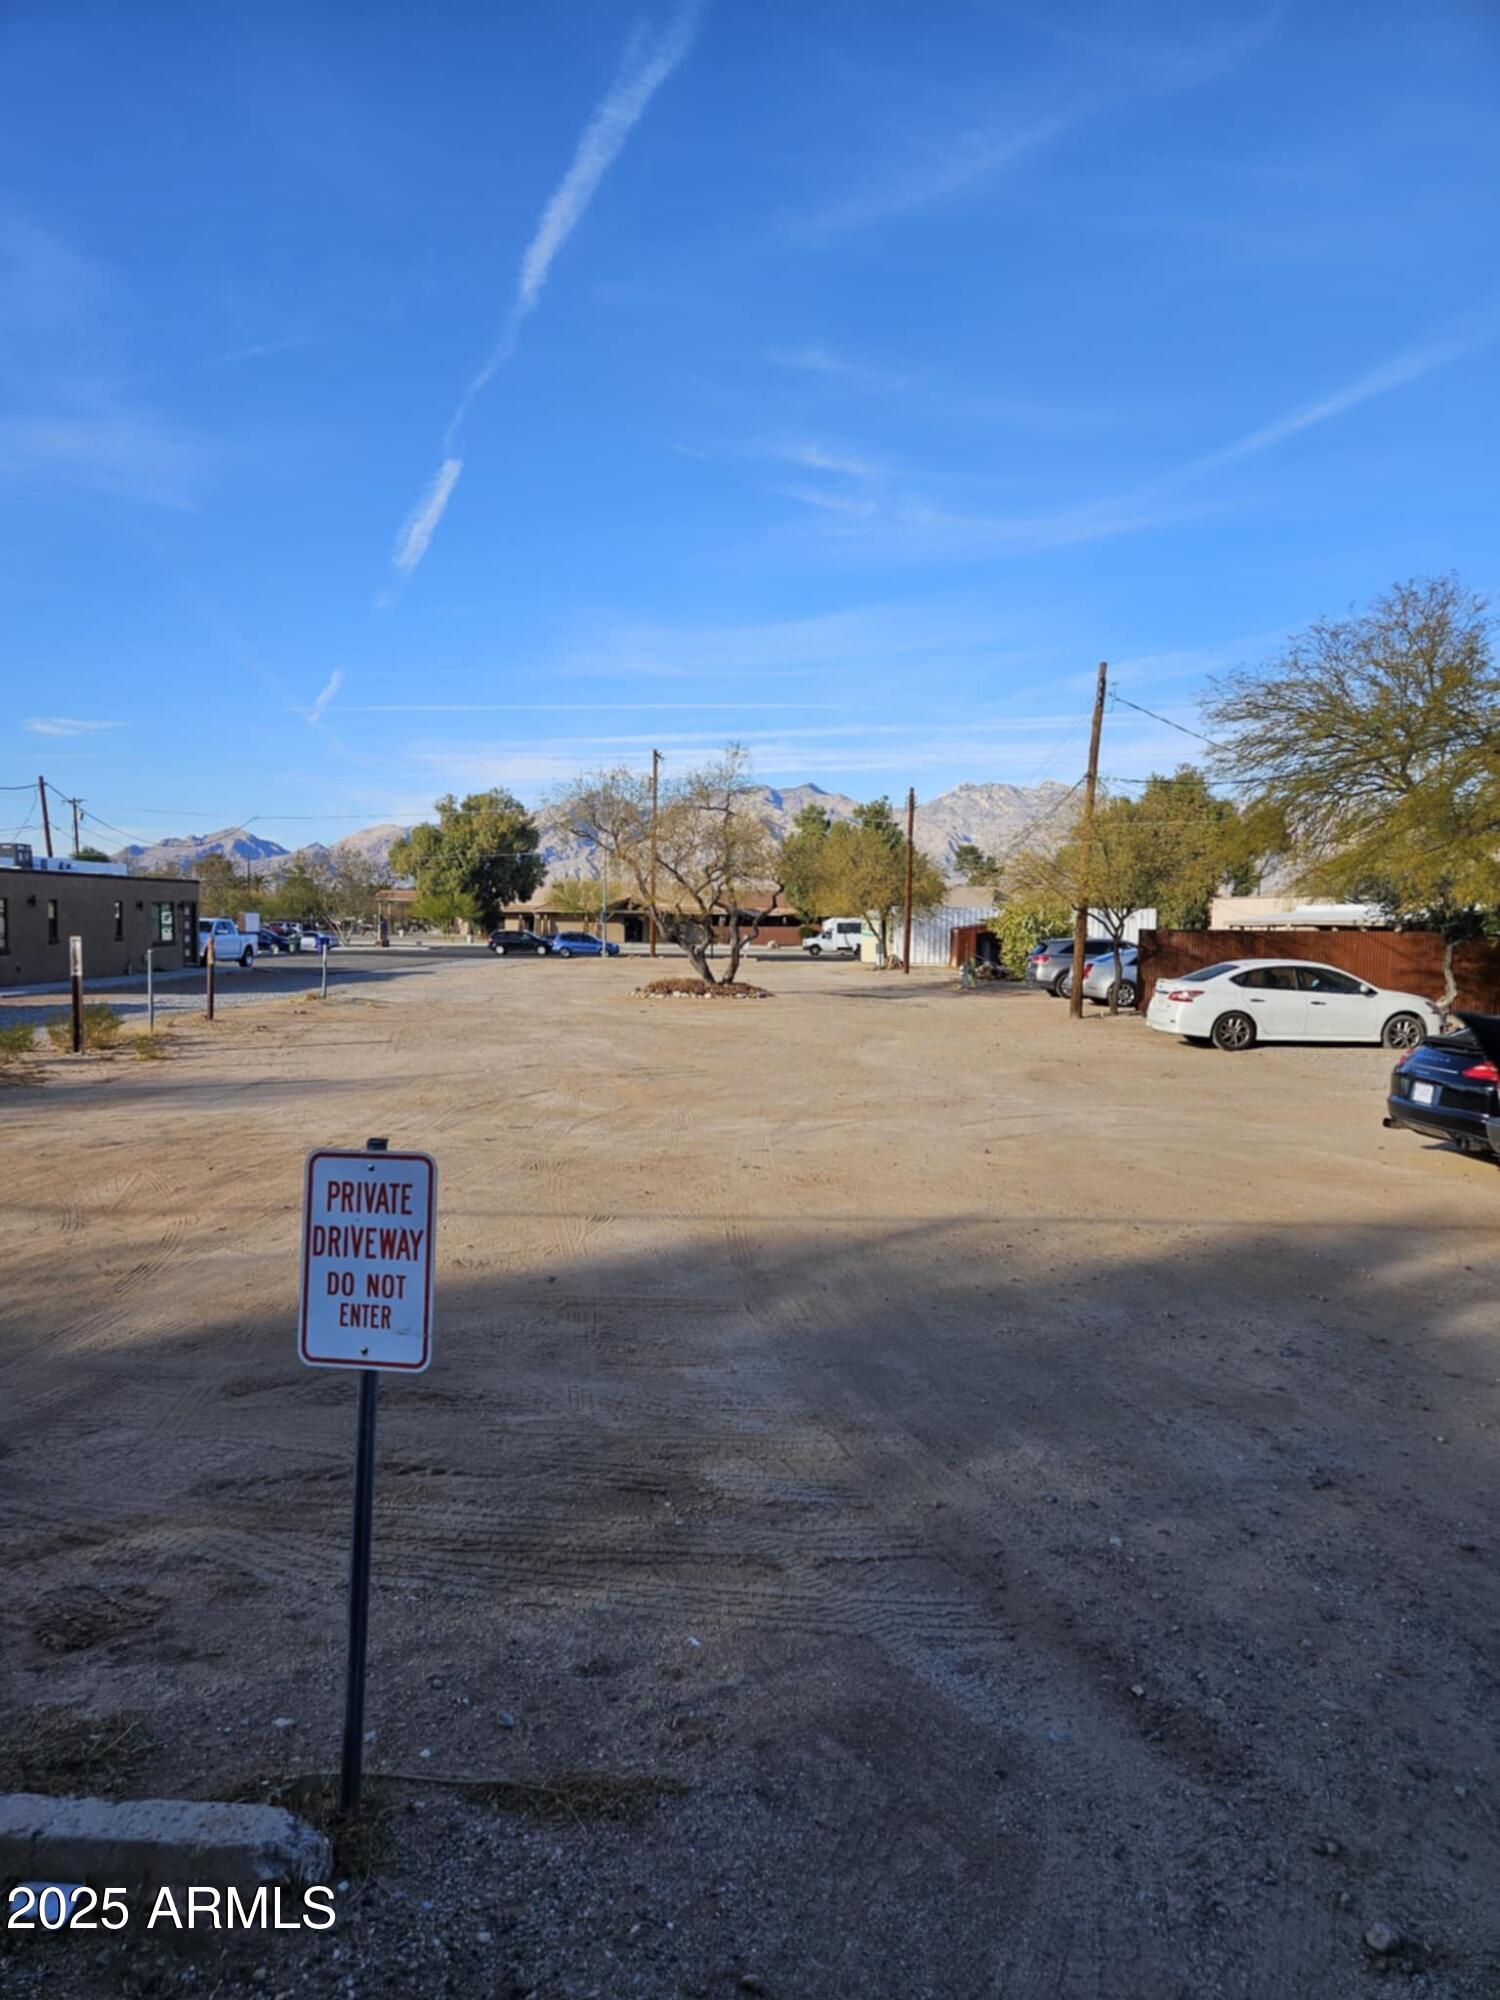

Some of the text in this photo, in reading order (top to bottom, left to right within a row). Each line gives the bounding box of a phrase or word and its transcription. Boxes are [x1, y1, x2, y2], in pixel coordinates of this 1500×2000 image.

[326, 1180, 413, 1215] PRIVATE
[312, 1225, 424, 1261] DRIVEWAY
[326, 1271, 407, 1300] DO NOT
[339, 1302, 392, 1330] ENTER
